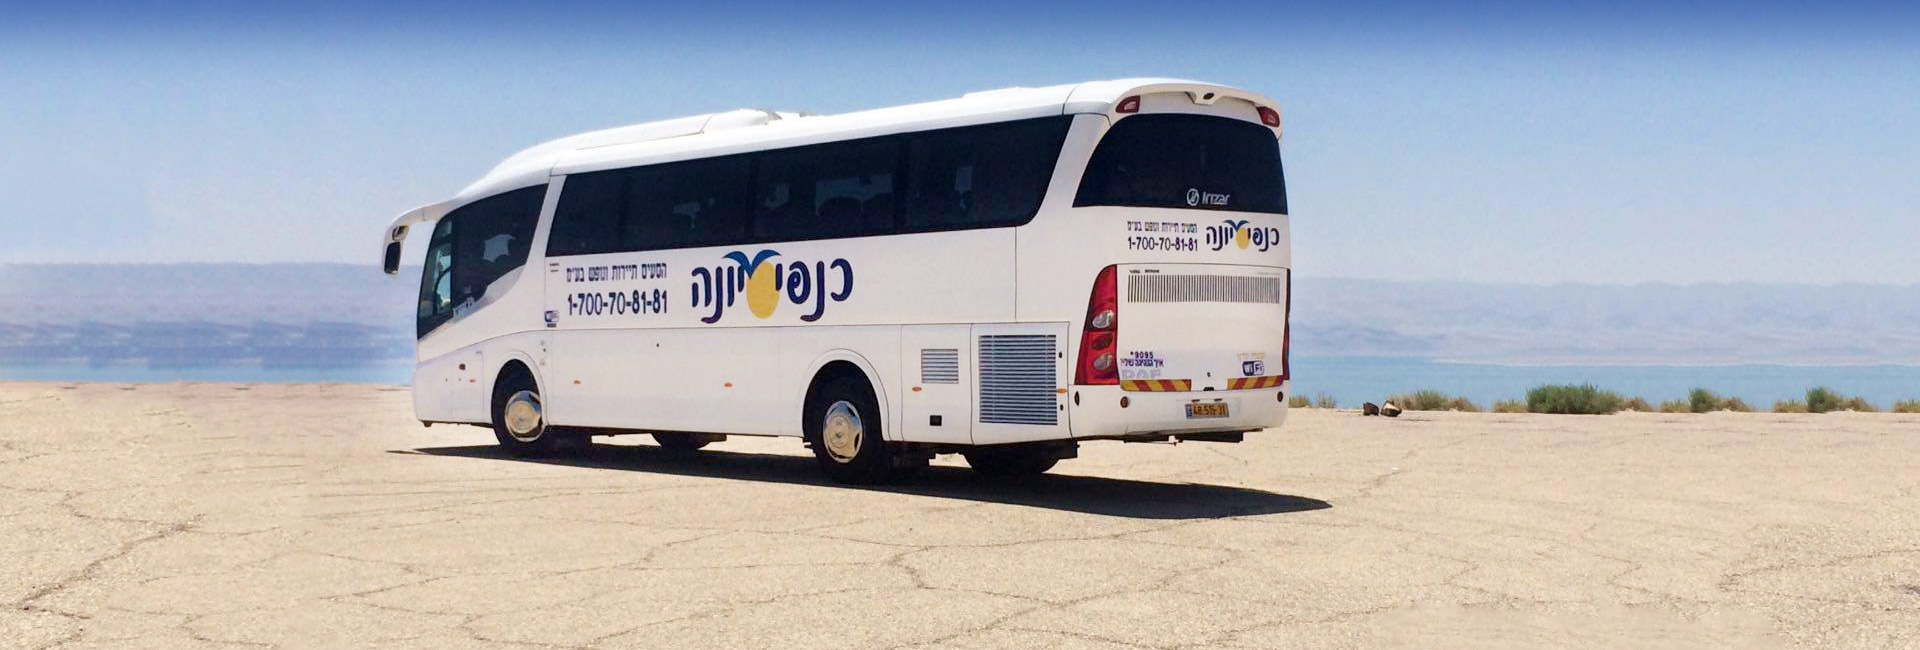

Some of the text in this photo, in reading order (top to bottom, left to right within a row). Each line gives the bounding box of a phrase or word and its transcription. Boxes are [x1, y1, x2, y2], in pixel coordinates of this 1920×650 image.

[1128, 236, 1198, 251] 1-700-70-81-81
[612, 264, 638, 280] תיירות
[641, 262, 667, 279] הסעים
[774, 257, 854, 322] כנפי
[567, 288, 667, 315] 1-700-70-81-81
